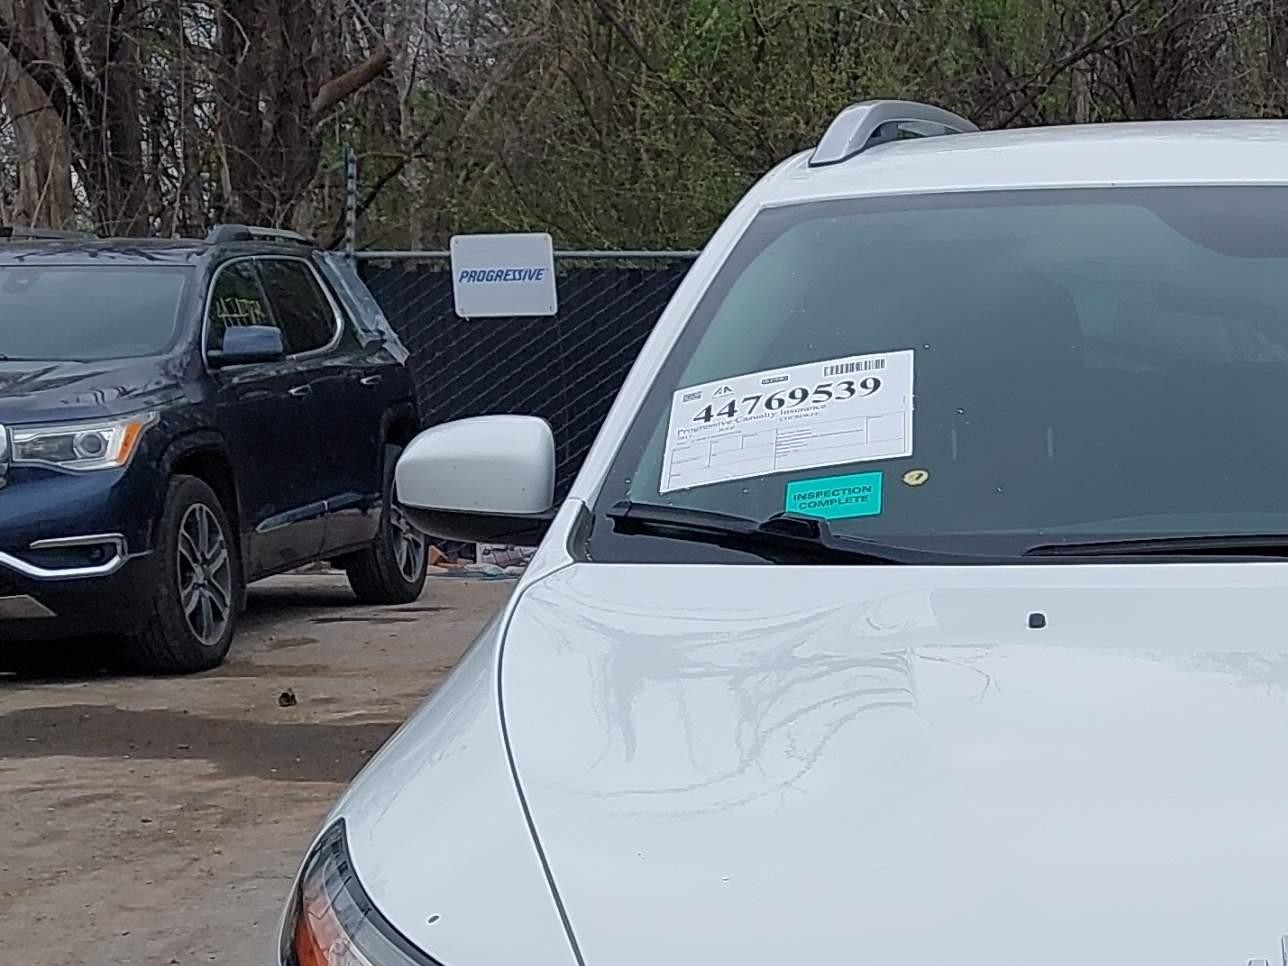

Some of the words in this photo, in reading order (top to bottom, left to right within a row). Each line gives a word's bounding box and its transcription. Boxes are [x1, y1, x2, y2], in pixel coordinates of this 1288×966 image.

[459, 268, 545, 283] PROGRESSIVE
[691, 376, 882, 424] 44769539
[793, 485, 872, 501] INSPECTION
[798, 494, 869, 510] COMPLETE
